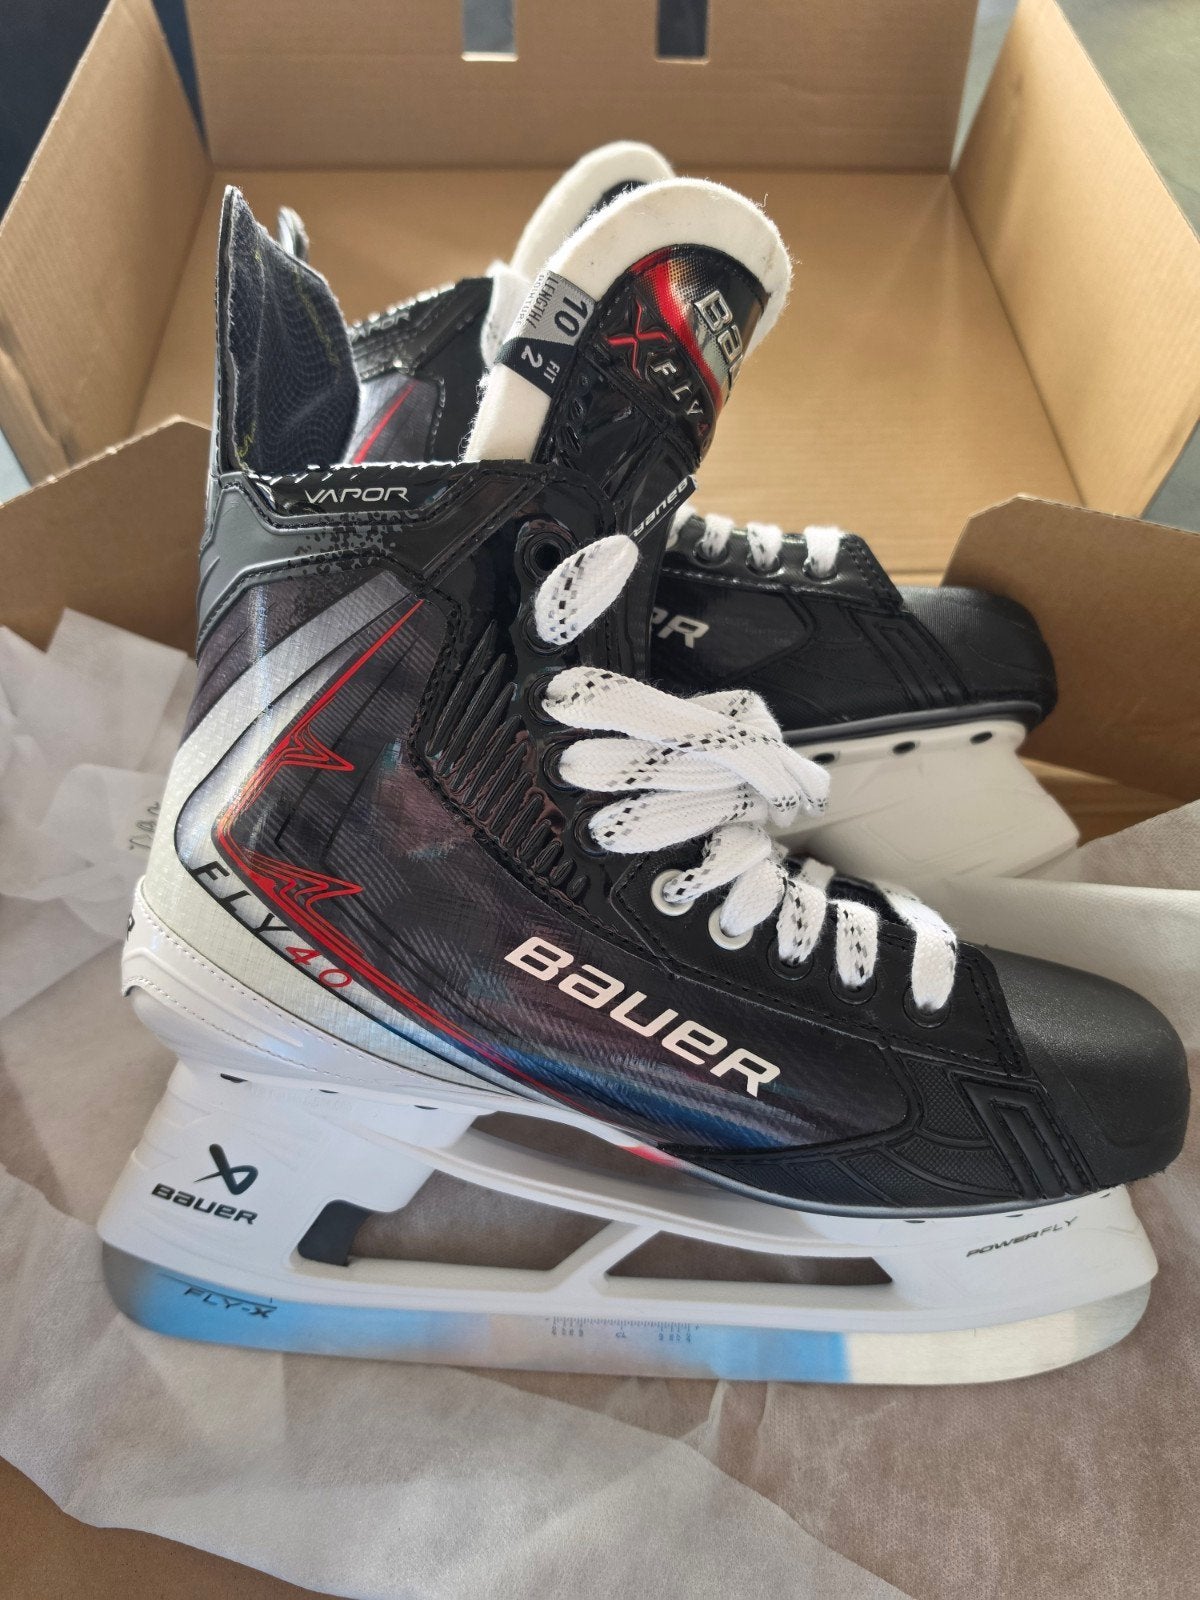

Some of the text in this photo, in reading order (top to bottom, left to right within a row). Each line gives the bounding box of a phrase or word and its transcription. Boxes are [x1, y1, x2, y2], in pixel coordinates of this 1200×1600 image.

[554, 296, 588, 337] 10
[521, 345, 543, 368] 2
[543, 360, 561, 384] FIT
[649, 361, 704, 416] FLY
[304, 486, 410, 504] VAPOR
[187, 861, 292, 936] FLY
[285, 945, 352, 988] 40
[183, 1286, 276, 1319] FLY-X
